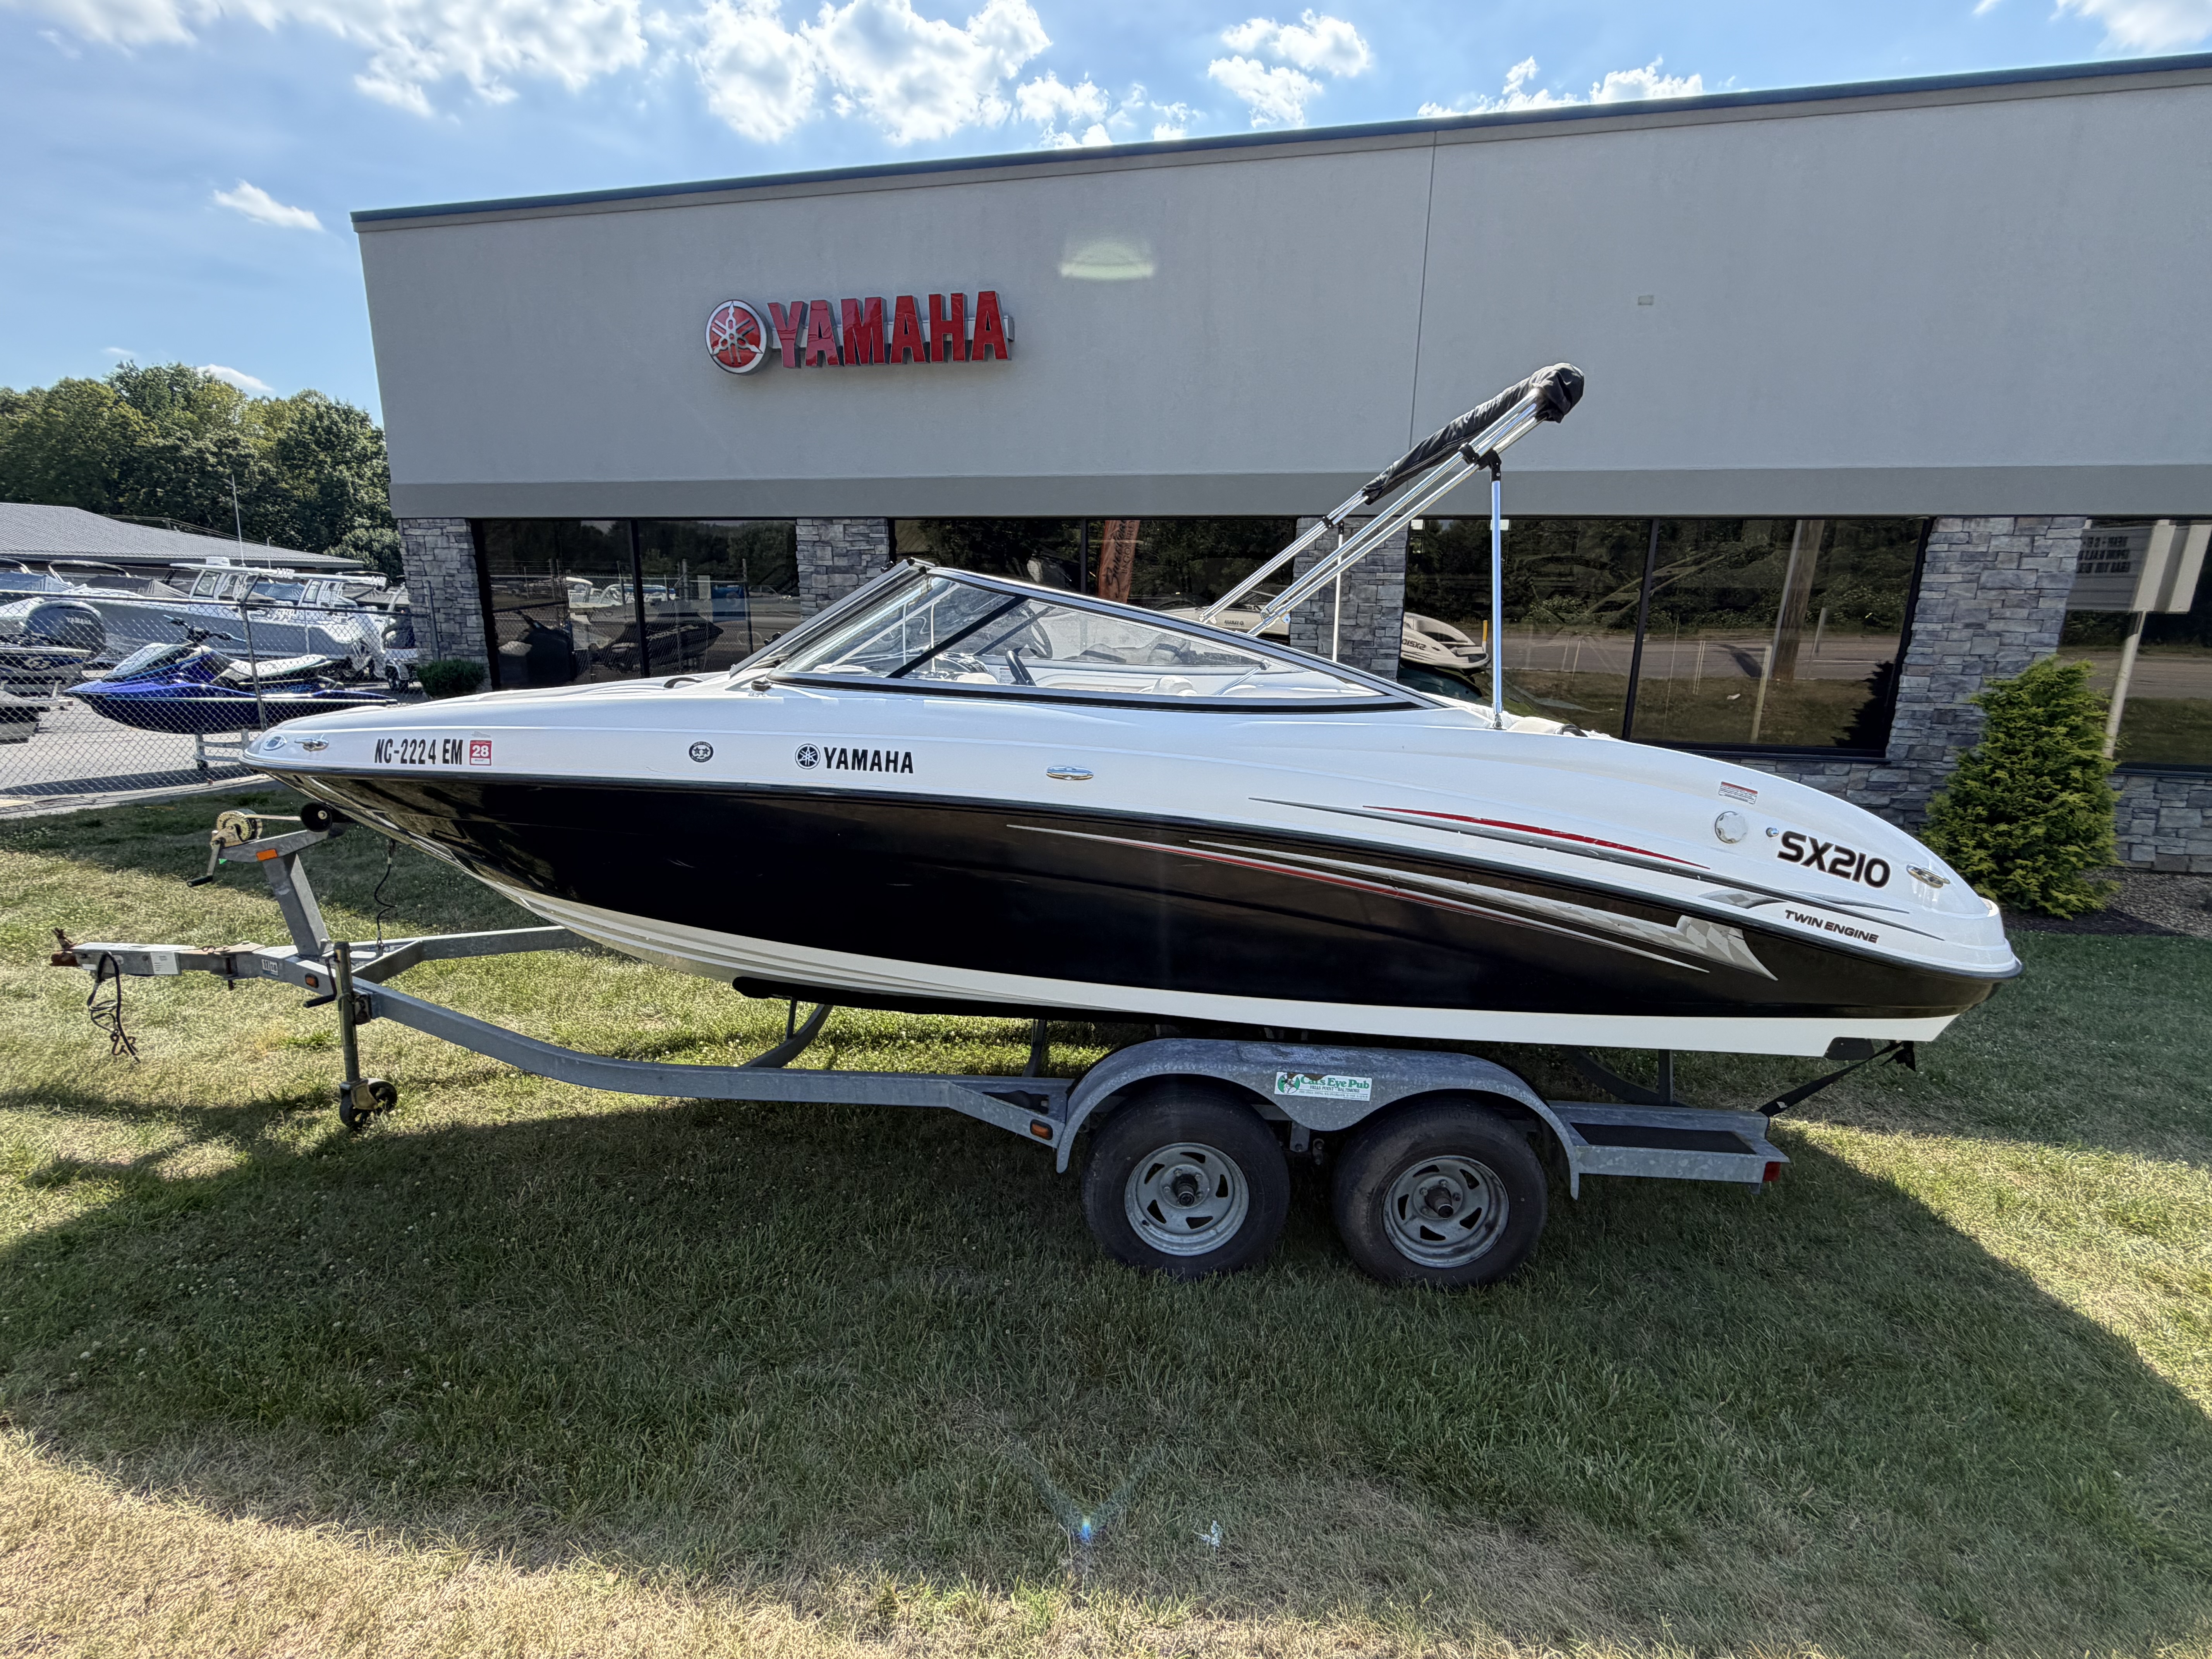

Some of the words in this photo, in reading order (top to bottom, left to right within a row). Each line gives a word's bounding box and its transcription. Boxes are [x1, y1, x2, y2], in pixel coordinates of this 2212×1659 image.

[767, 290, 1009, 369] YAMAHA
[374, 738, 436, 765] NC-2224
[442, 738, 464, 765] EM
[472, 745, 489, 757] 28
[823, 747, 914, 773] YAMAHA
[1777, 830, 1891, 888] SX210
[1785, 909, 1824, 928] TWIN
[1824, 921, 1879, 944] ENGINE
[1327, 1077, 1347, 1088] Eye
[1348, 1079, 1370, 1089] Pub
